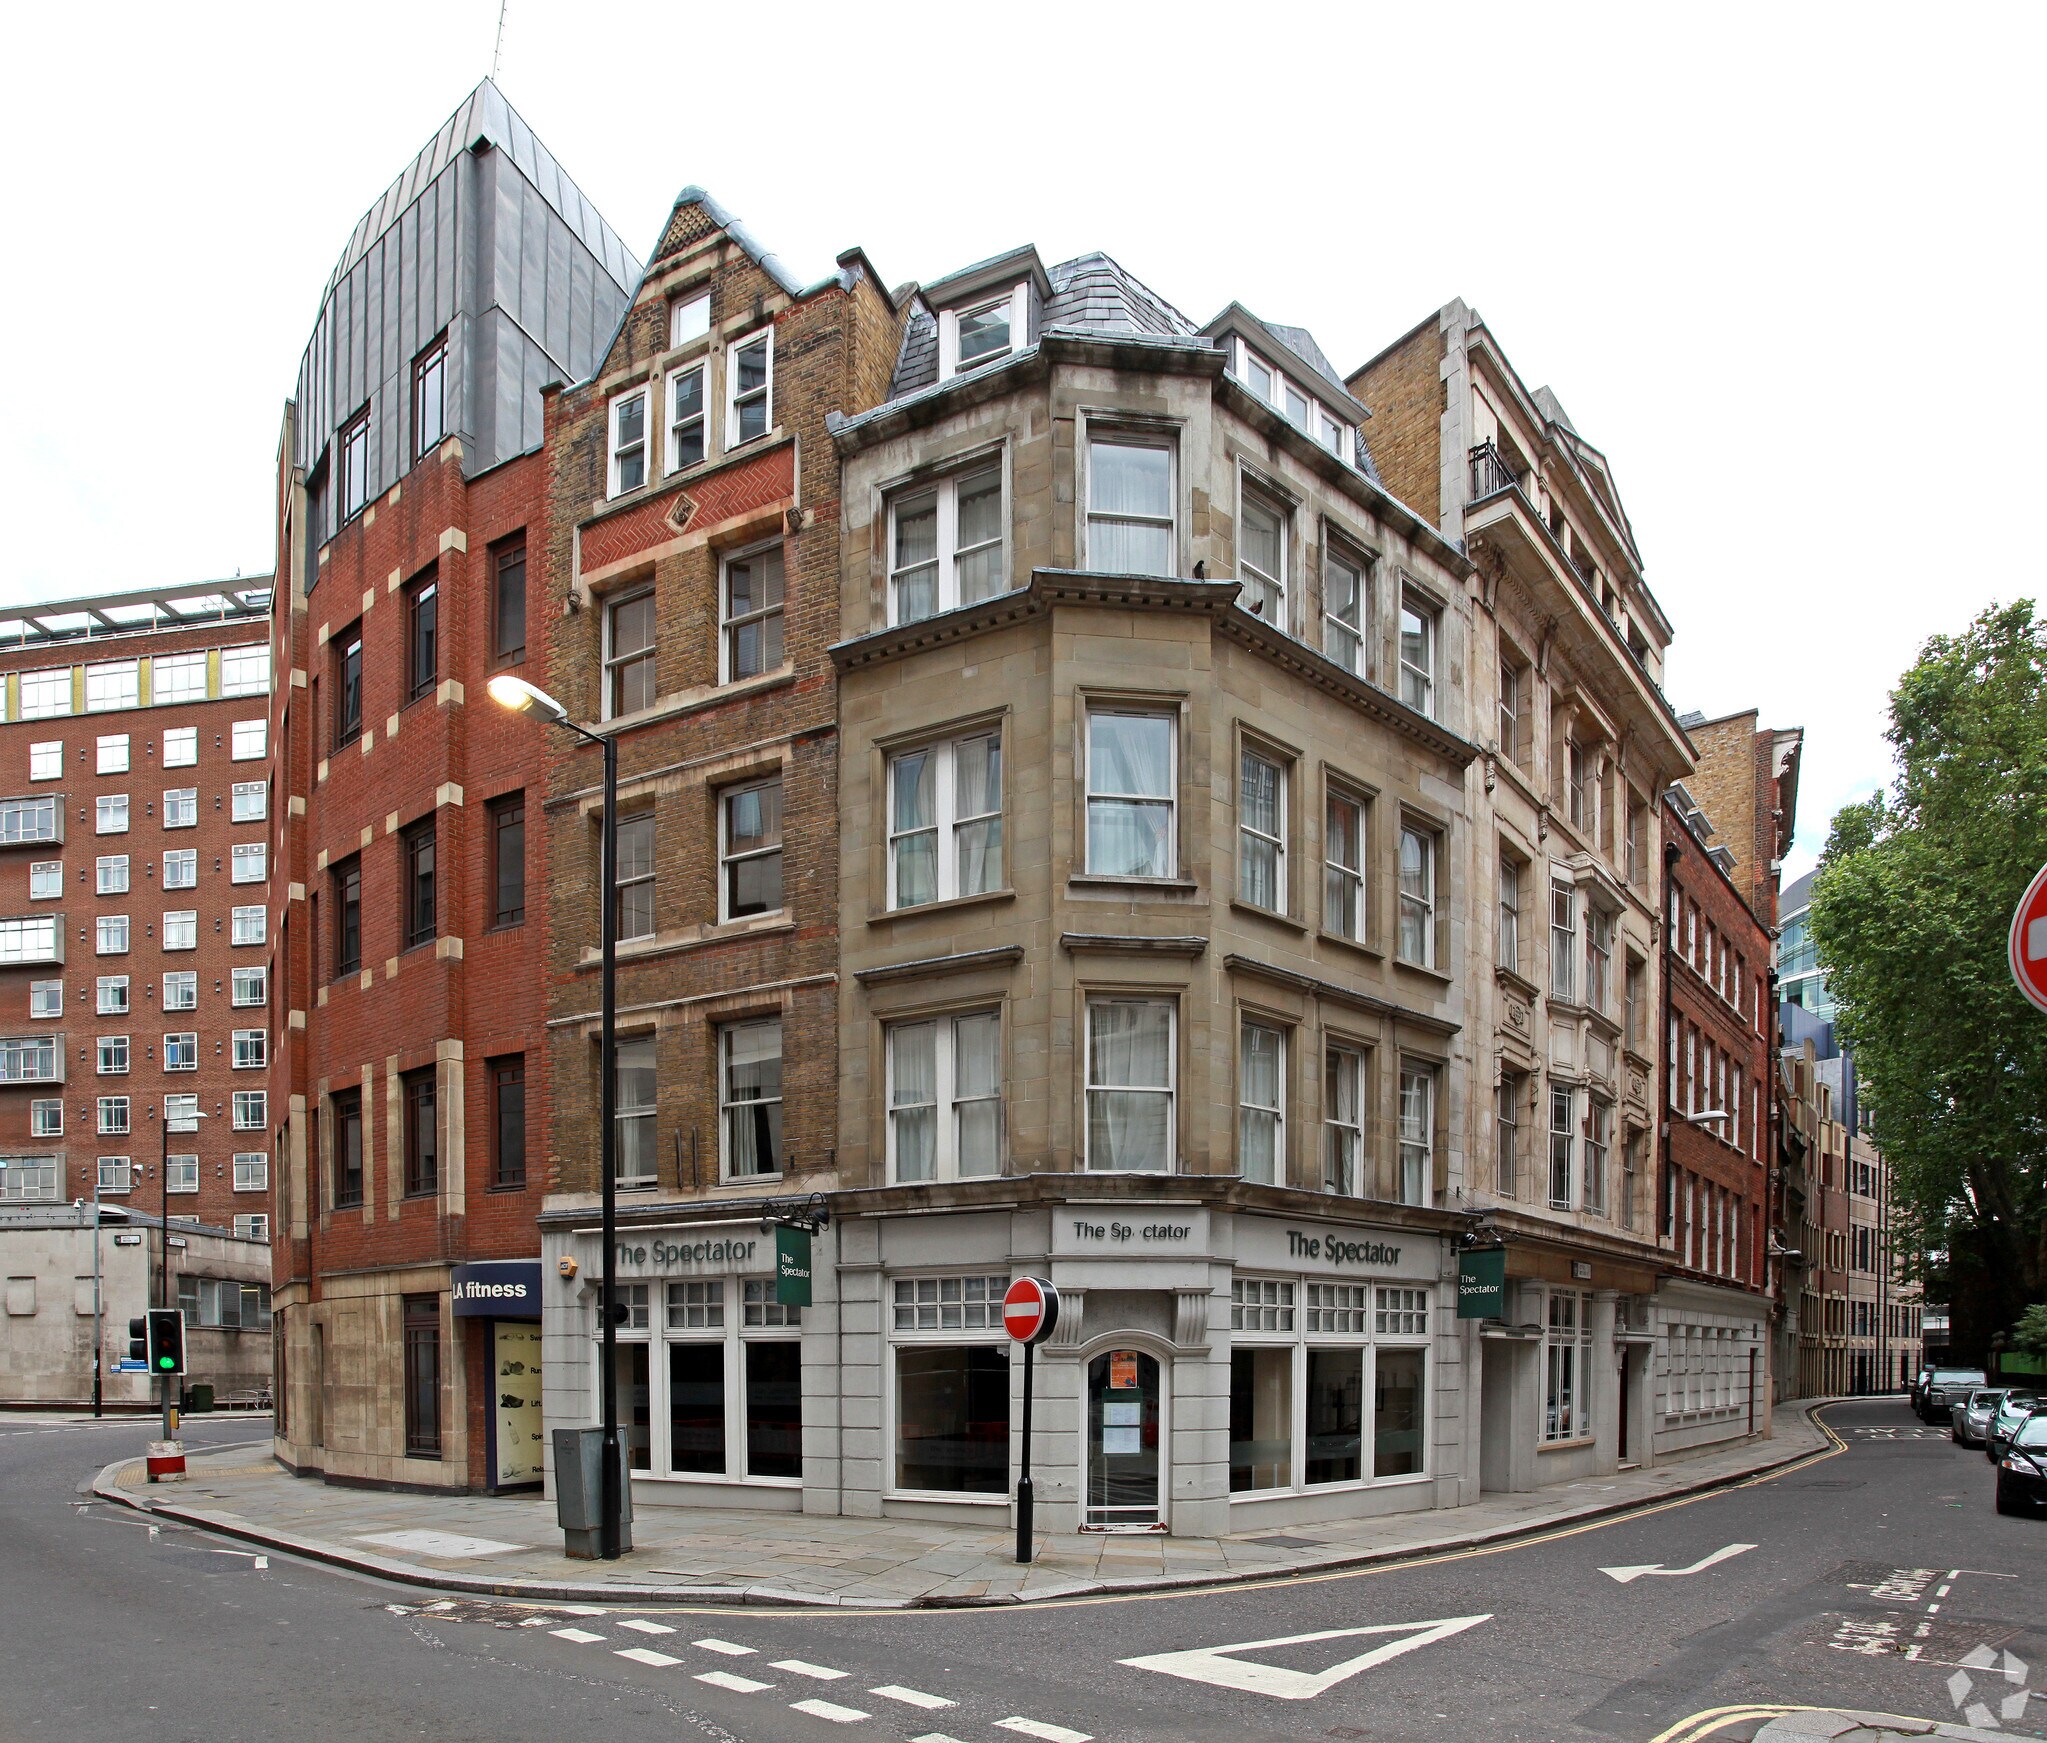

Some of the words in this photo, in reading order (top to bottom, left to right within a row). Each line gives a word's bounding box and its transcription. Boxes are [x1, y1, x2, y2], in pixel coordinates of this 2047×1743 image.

[1074, 1222, 1105, 1239] The
[1110, 1222, 1191, 1242] Spctator
[652, 1239, 756, 1267] Spectator
[1286, 1230, 1320, 1258] The
[1325, 1234, 1401, 1266] Spectator
[781, 1253, 794, 1264] The
[781, 1265, 811, 1278] Spectator
[1460, 1275, 1476, 1283] The
[452, 1283, 464, 1300] LA
[466, 1281, 527, 1299] fitness
[1459, 1285, 1499, 1296] Spectator
